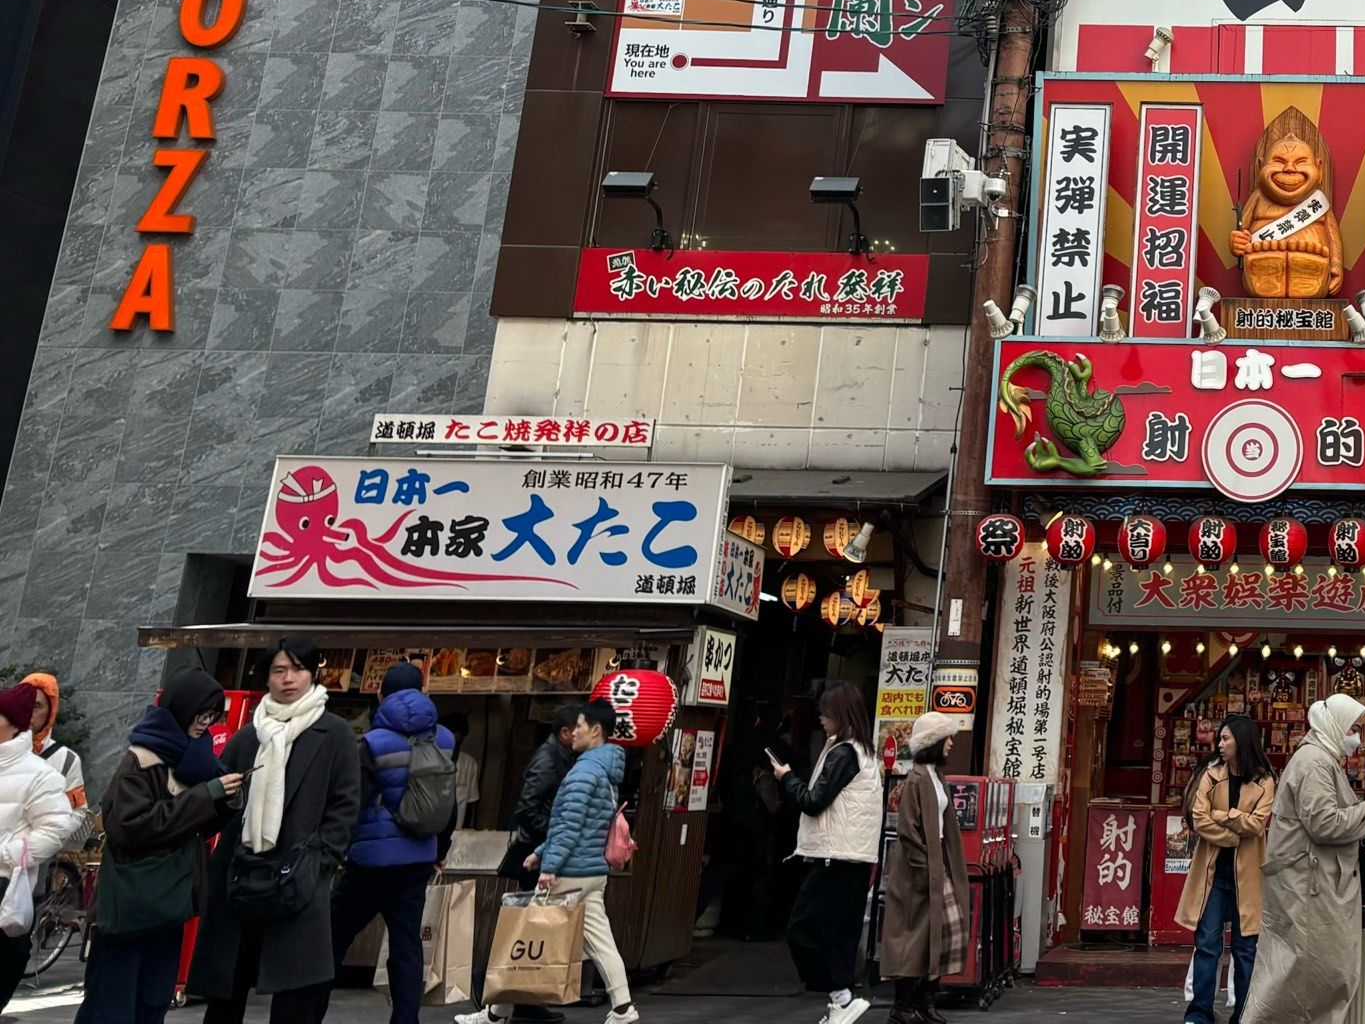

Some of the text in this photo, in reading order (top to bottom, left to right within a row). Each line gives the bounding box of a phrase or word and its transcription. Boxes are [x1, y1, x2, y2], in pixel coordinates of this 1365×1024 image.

[623, 58, 667, 69] You are
[624, 43, 670, 59] 現在地
[630, 69, 656, 78] here
[1051, 124, 1100, 322] 実弾禁止
[1139, 123, 1191, 324] 開運招福
[1258, 196, 1322, 241] 実弾禁止
[819, 303, 898, 315] 昭和35年創業
[1234, 306, 1335, 330] 射的秘宝館
[1190, 349, 1322, 391] 日本一
[375, 418, 651, 445] 道頓堀 たこ焼発祥の店
[353, 468, 470, 505] 日本一
[521, 469, 689, 493] 創業昭和47年
[401, 515, 489, 559] 本家
[490, 494, 699, 568] 大たこ
[979, 518, 1020, 556] 祭
[1060, 518, 1086, 561] 射的
[1127, 518, 1153, 561] 大当り
[1199, 517, 1224, 561] 射的
[1268, 519, 1290, 564] 秘宝館
[1333, 520, 1360, 564] 射的
[634, 574, 698, 596] 道頓堀
[1106, 563, 1125, 614] 景品付
[704, 633, 733, 673] 串かつ
[1002, 555, 1037, 779] 元祖新世界道頓堀秘宝館
[881, 692, 924, 703] 店内でも
[1097, 814, 1137, 891] 射的
[1084, 905, 1140, 926] 秘宝館
[510, 939, 545, 961] GU
